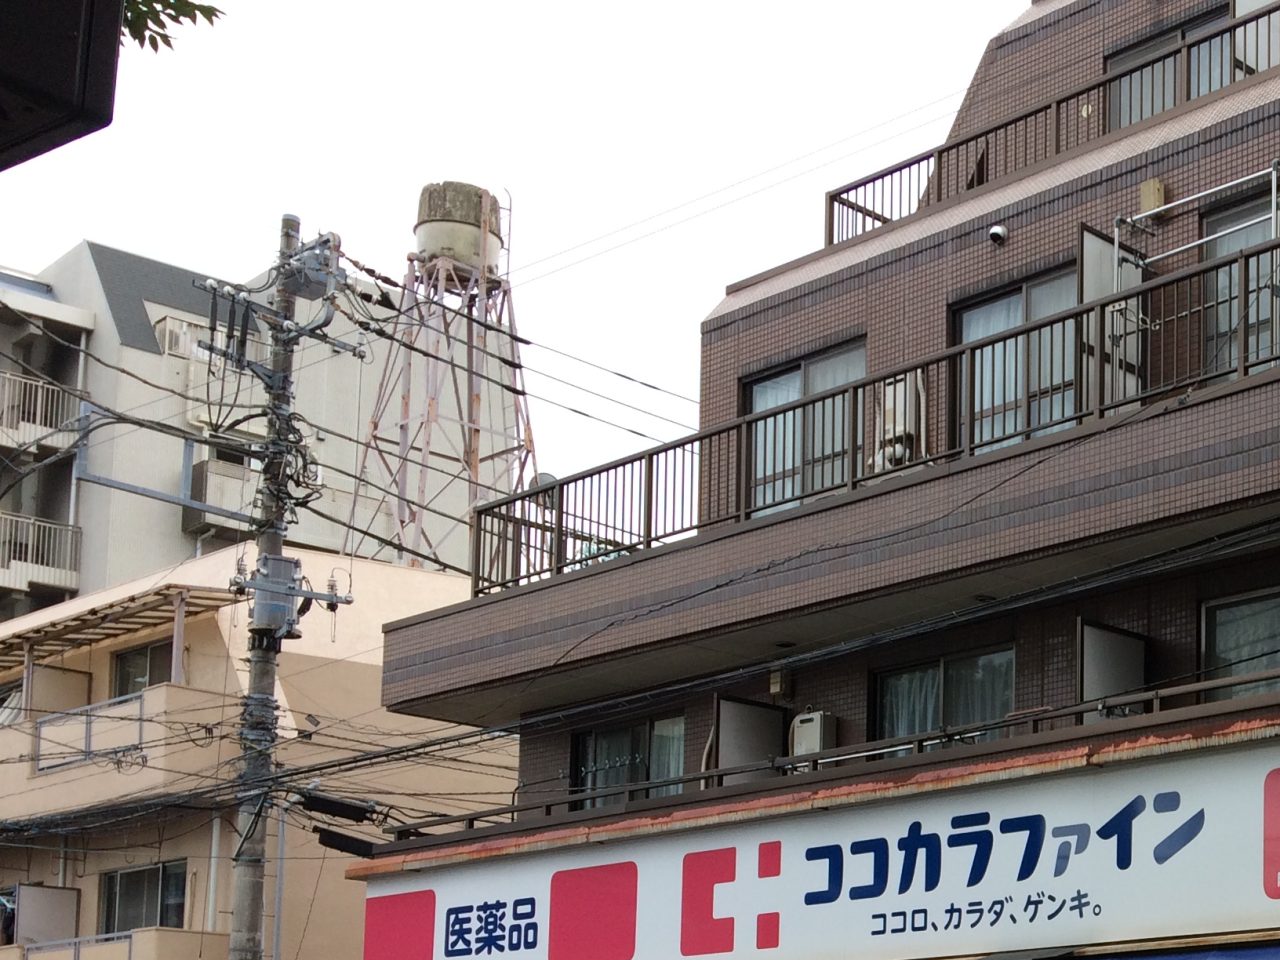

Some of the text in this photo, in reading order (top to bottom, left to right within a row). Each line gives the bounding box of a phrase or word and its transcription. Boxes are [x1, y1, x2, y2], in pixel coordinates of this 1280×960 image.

[804, 791, 1205, 906] ココカラファイン
[444, 897, 538, 957] 医薬品
[871, 889, 1103, 936] ココロ、カラダ、ゲンキ。
